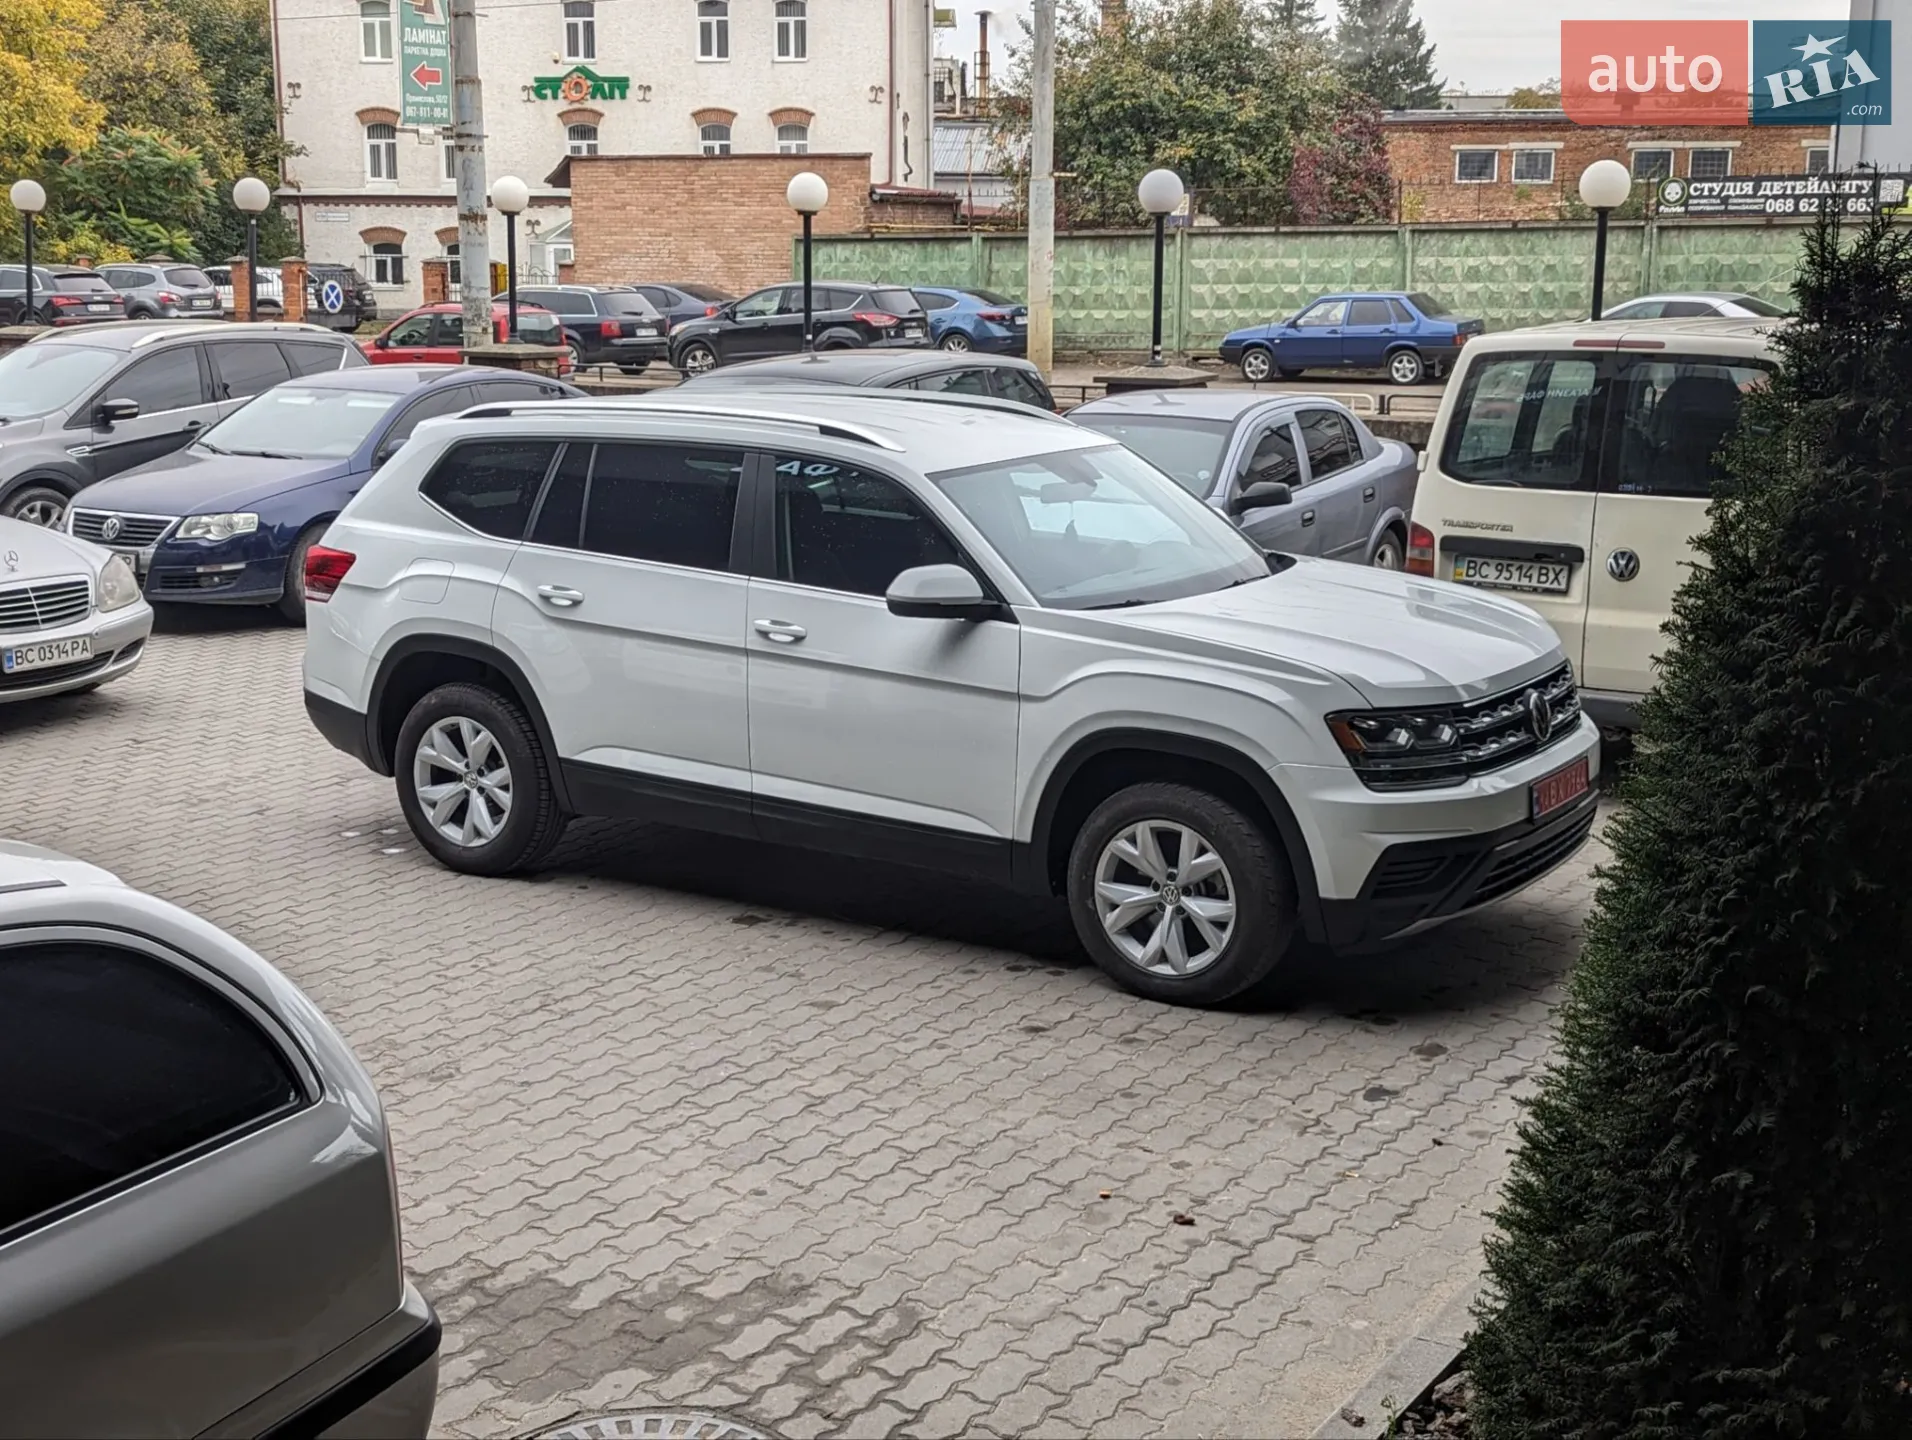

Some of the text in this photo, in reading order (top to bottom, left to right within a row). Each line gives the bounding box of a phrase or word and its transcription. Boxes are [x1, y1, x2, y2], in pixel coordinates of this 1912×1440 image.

[403, 27, 447, 45] ЛАМІНАТ
[1688, 181, 1755, 197] СТУДІЯ
[1765, 197, 1795, 213] 068
[1799, 197, 1820, 213] 62
[1441, 518, 1514, 533] TRANSPORTER
[1465, 559, 1564, 587] BC 9514 BX
[14, 647, 35, 666] BC
[38, 642, 69, 663] 0314
